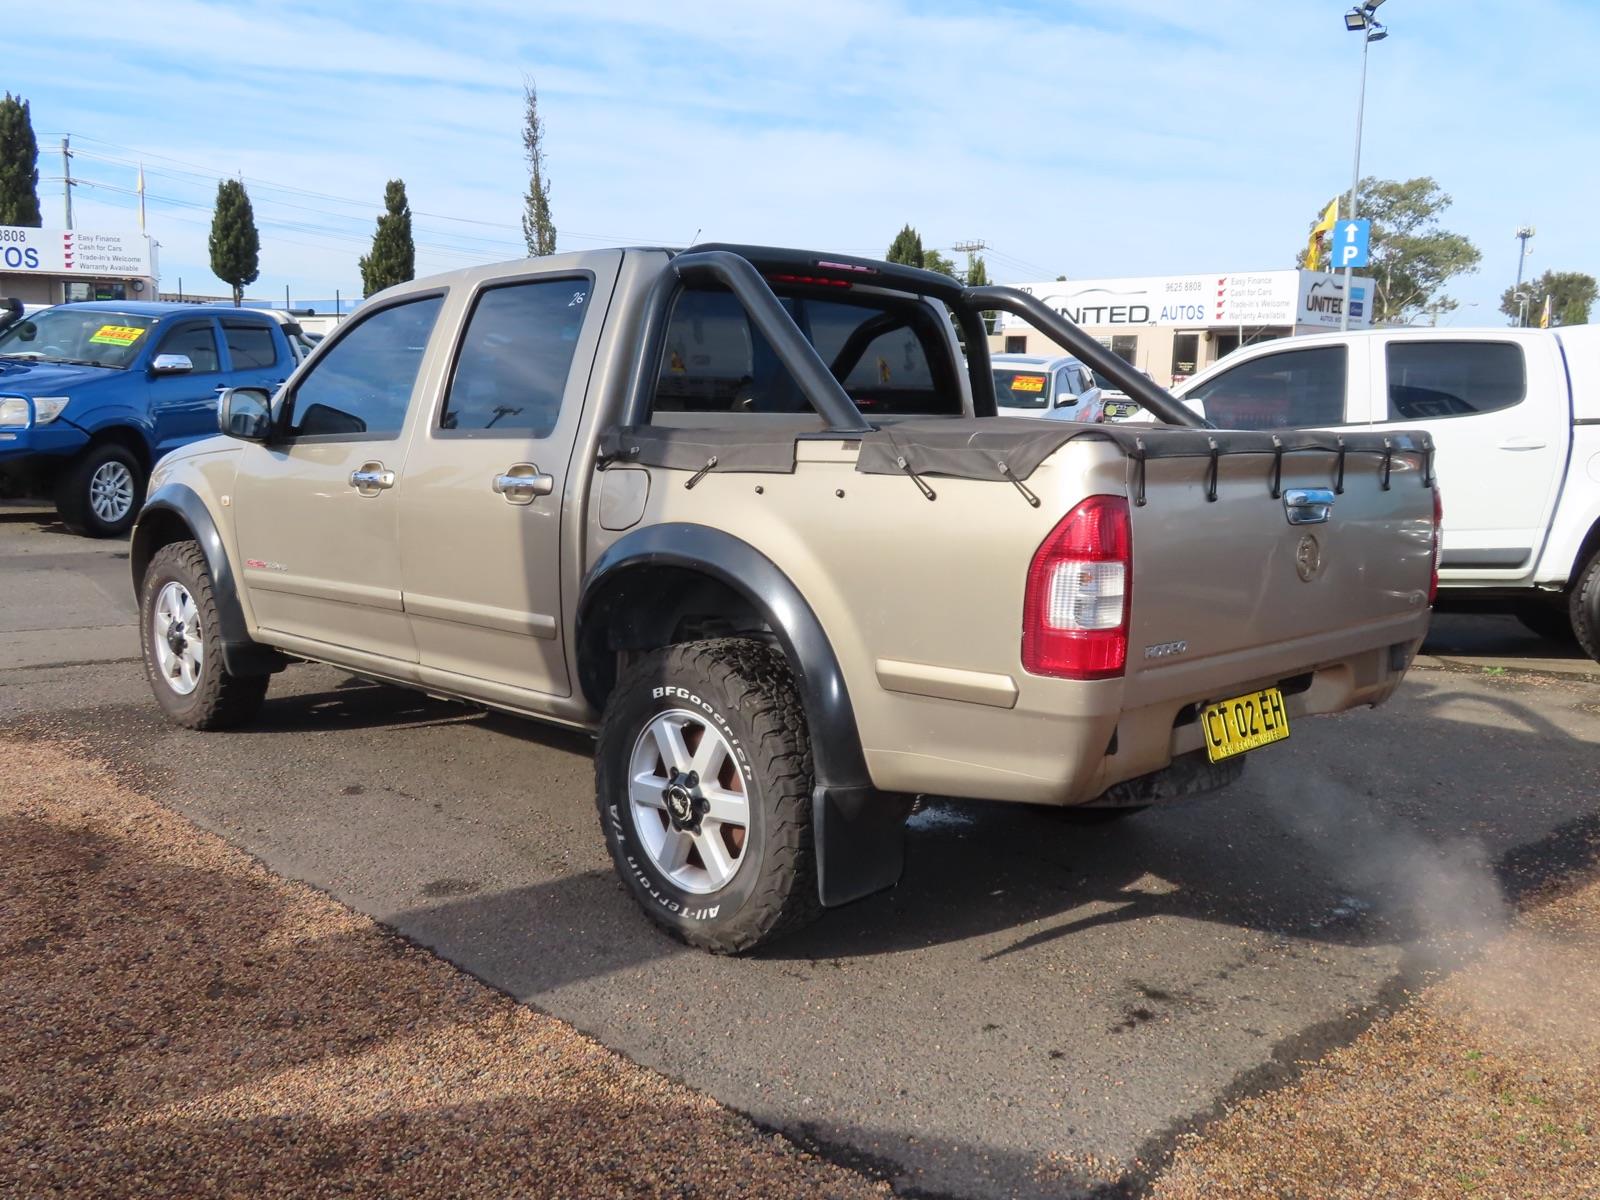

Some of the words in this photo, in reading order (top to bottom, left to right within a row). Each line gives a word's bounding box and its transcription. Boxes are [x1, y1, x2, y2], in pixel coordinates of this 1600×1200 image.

[77, 233, 94, 242] Easy
[95, 234, 121, 243] Finance
[78, 243, 95, 251] Cash
[107, 244, 122, 252] Cars
[0, 246, 39, 268] OS
[112, 255, 141, 263] Welcome
[1342, 245, 1358, 265] P
[79, 262, 108, 272] Warranty
[110, 263, 139, 272] Available
[1230, 276, 1246, 287] Easy
[1247, 276, 1272, 285] Finance
[1165, 282, 1183, 293] 9625
[1184, 281, 1202, 292] 8808
[1261, 299, 1290, 308] Welcome
[1160, 304, 1205, 321] AUTOS
[1229, 312, 1256, 321] Warranty
[1257, 311, 1287, 320] Available
[1207, 707, 1231, 747] CT
[1260, 693, 1285, 731] EH
